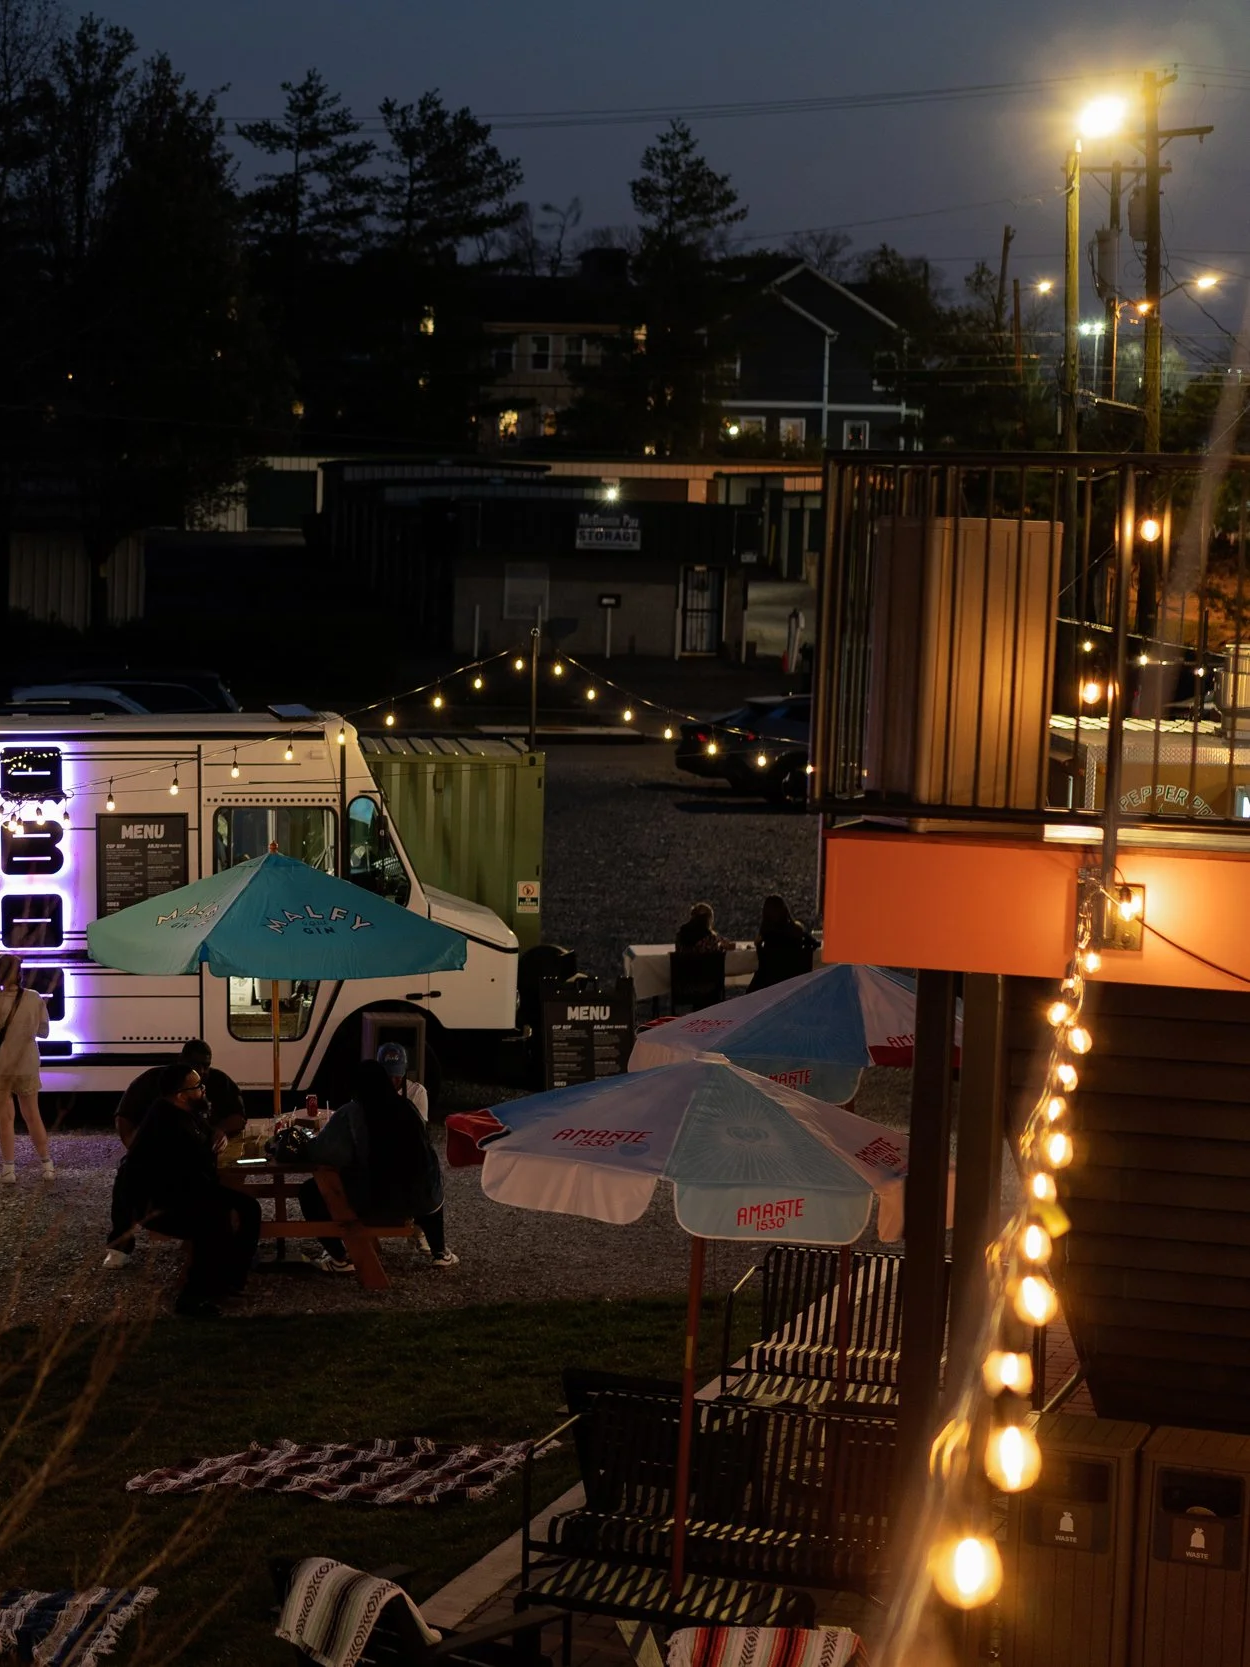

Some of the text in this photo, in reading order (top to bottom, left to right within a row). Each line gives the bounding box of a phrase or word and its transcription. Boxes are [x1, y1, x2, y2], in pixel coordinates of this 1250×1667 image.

[578, 531, 639, 542] STORAGE
[1118, 784, 1190, 812] PEPPER
[121, 824, 165, 840] MENU
[262, 904, 375, 935] MALFY
[303, 927, 337, 935] GIN
[566, 1005, 611, 1021] MENU
[552, 1128, 654, 1143] AMANTE
[573, 1139, 615, 1147] 1530
[854, 1136, 901, 1168] AMANTE
[736, 1198, 806, 1227] AMANTE
[756, 1217, 786, 1232] 1530
[1054, 1534, 1078, 1544] WASTE
[1185, 1550, 1210, 1560] WASTE
